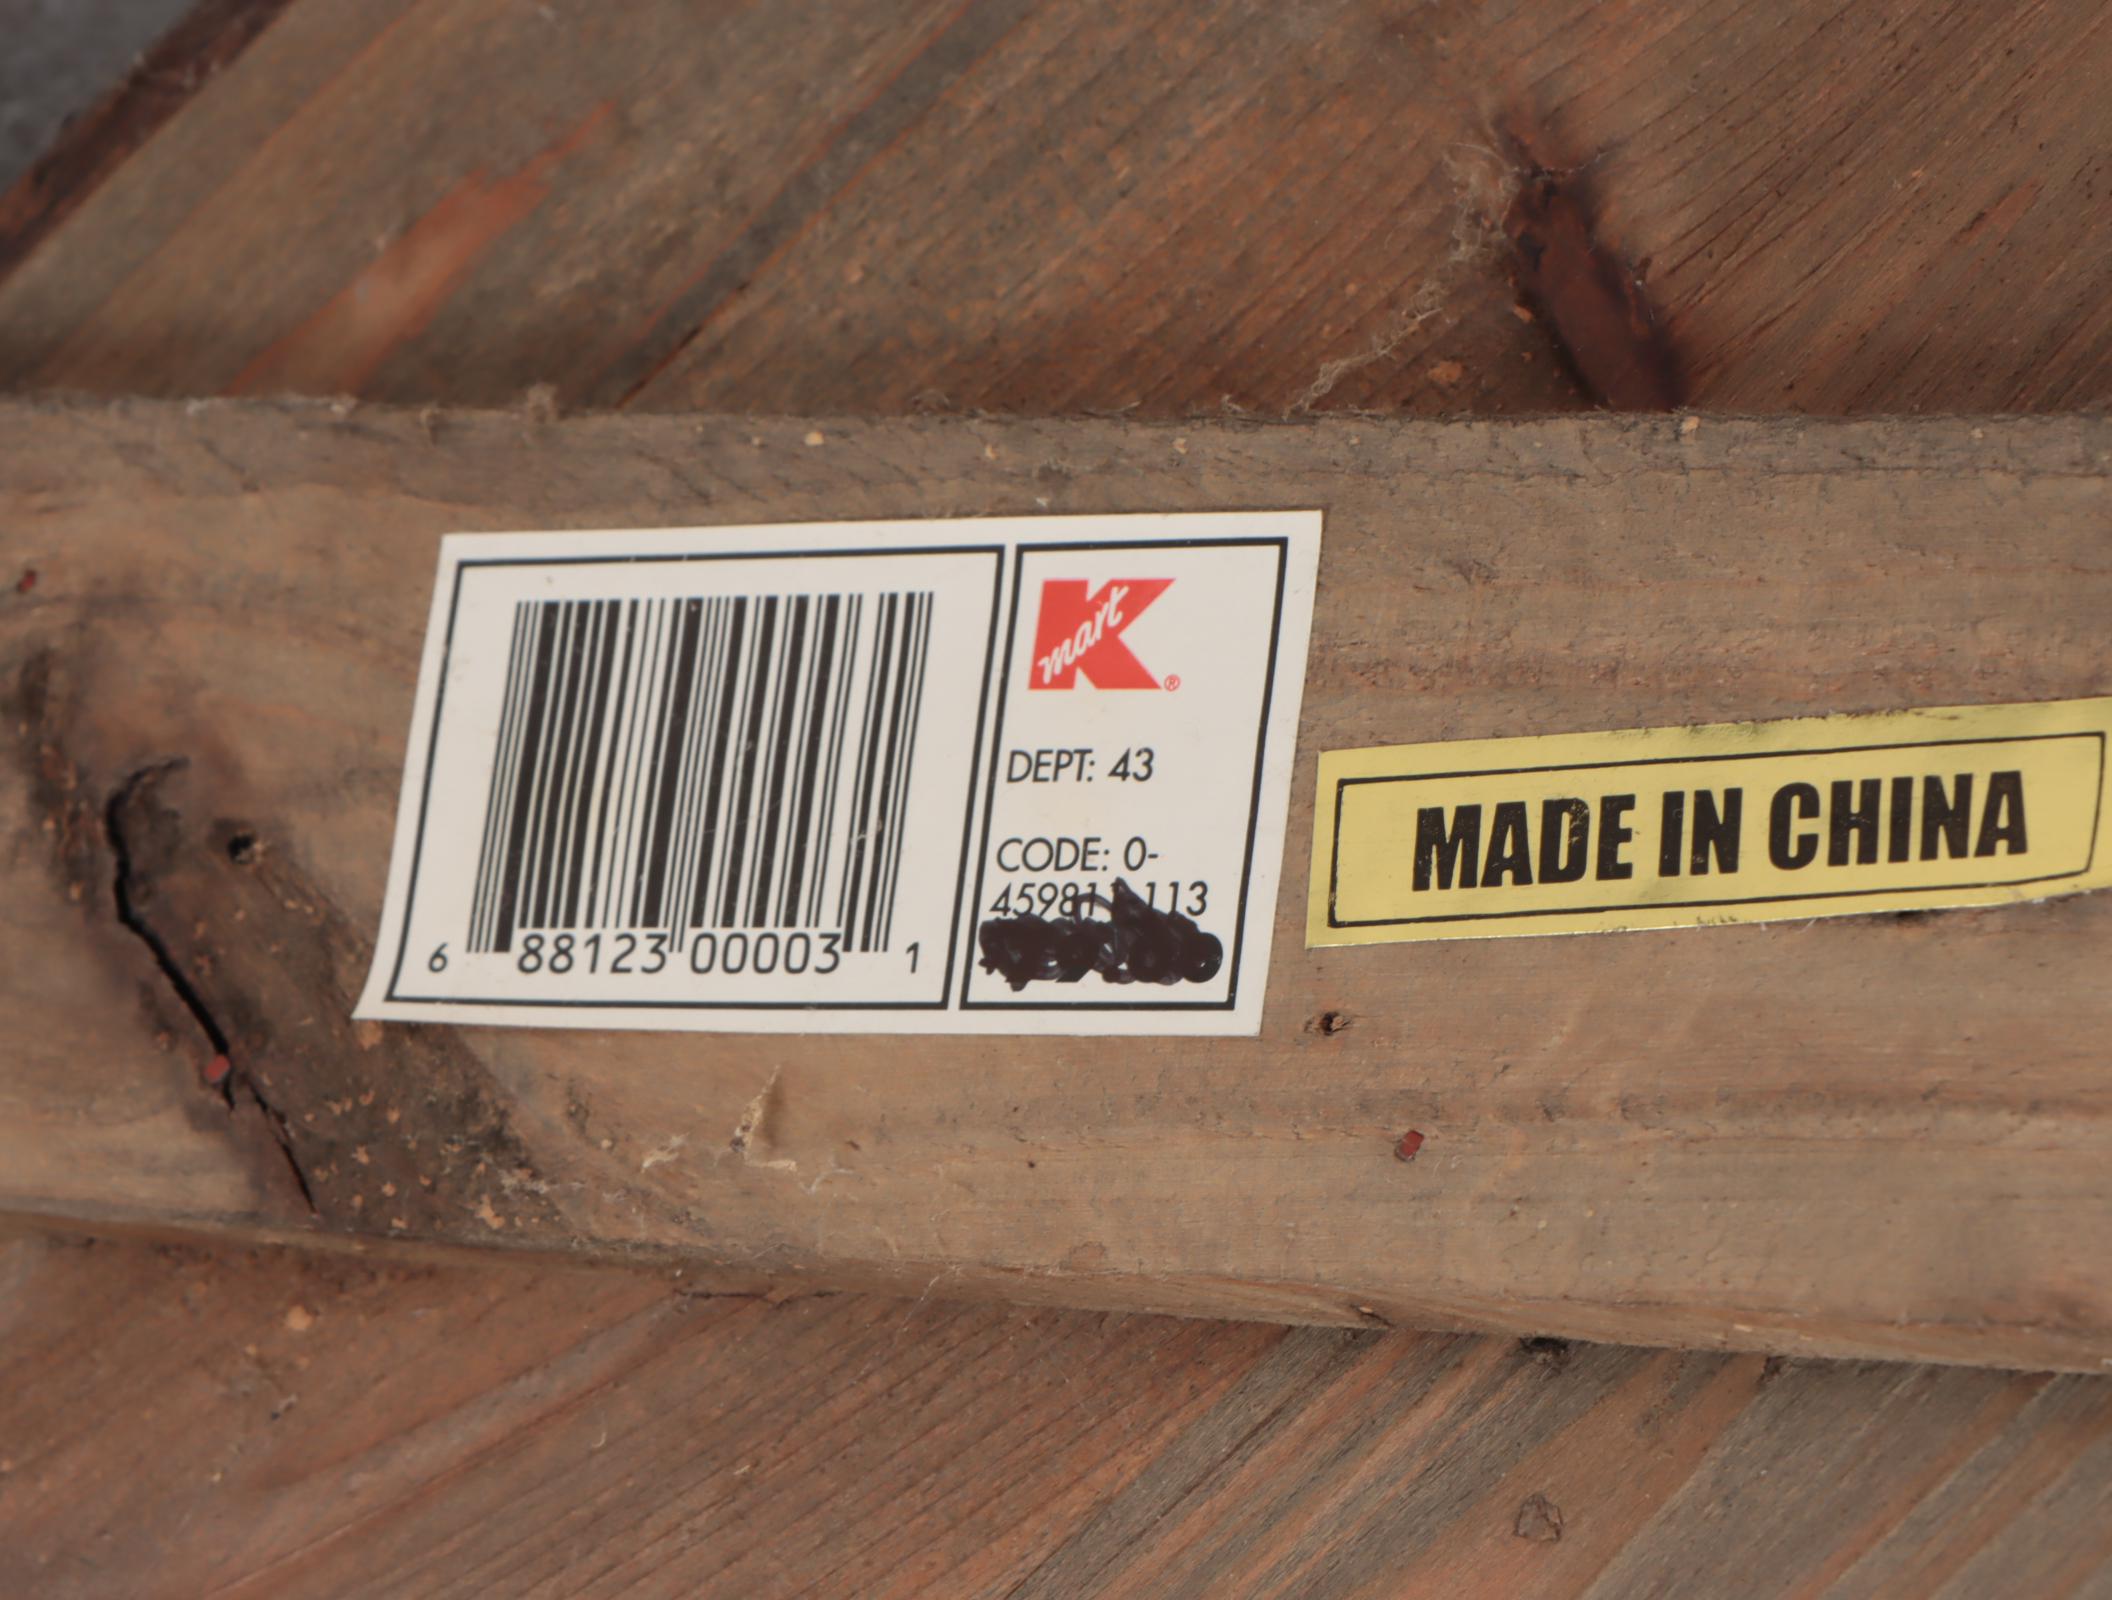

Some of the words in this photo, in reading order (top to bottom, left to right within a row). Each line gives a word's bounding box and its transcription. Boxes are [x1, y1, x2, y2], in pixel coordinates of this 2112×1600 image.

[1029, 579, 1176, 690] K
[1038, 586, 1129, 684] mart
[1006, 749, 1095, 782] DEPT:
[1108, 747, 1154, 781] 43
[996, 837, 1110, 872] CODE:
[1412, 793, 1635, 892] MADE
[1657, 787, 1743, 878] IN
[1769, 770, 2028, 871] CHINA
[428, 942, 449, 972] 6
[517, 932, 668, 974] 88123
[689, 933, 841, 974] 00003
[905, 941, 920, 973] 1
